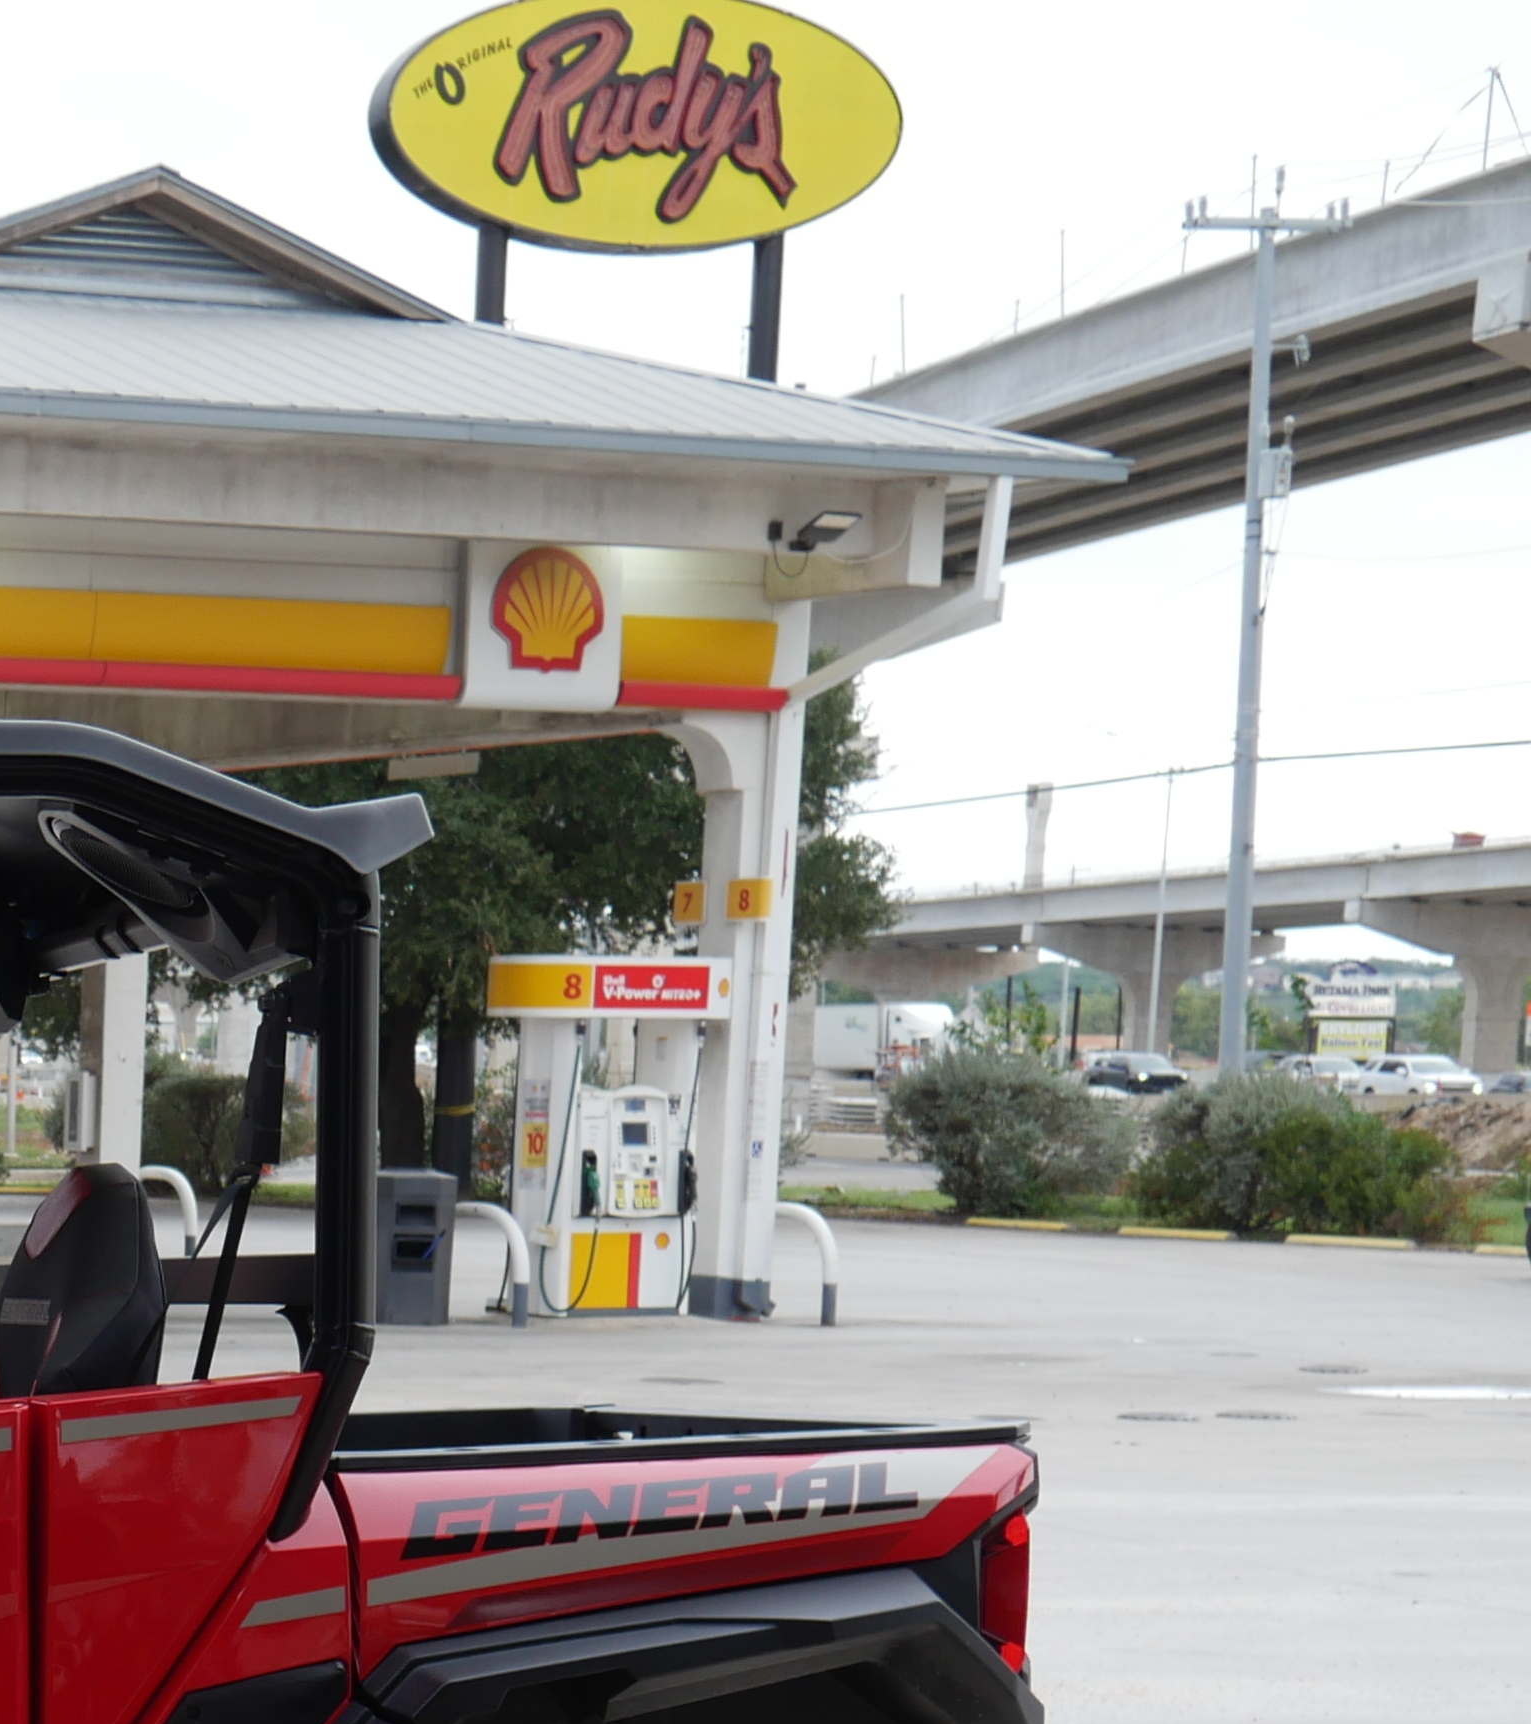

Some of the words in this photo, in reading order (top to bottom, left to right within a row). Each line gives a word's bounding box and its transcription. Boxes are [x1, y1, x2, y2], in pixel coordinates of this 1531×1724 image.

[413, 77, 435, 98] THE
[434, 36, 513, 106] ORIGINAL
[494, 9, 797, 223] Rudy's
[683, 892, 693, 913] 7
[739, 889, 750, 911] 8
[563, 973, 582, 999] 8
[603, 974, 625, 985] Shell
[1314, 985, 1359, 996] RETAMA
[1363, 985, 1390, 996] PARK
[603, 985, 657, 1000] V-Power
[400, 1462, 919, 1560] GENERAL
